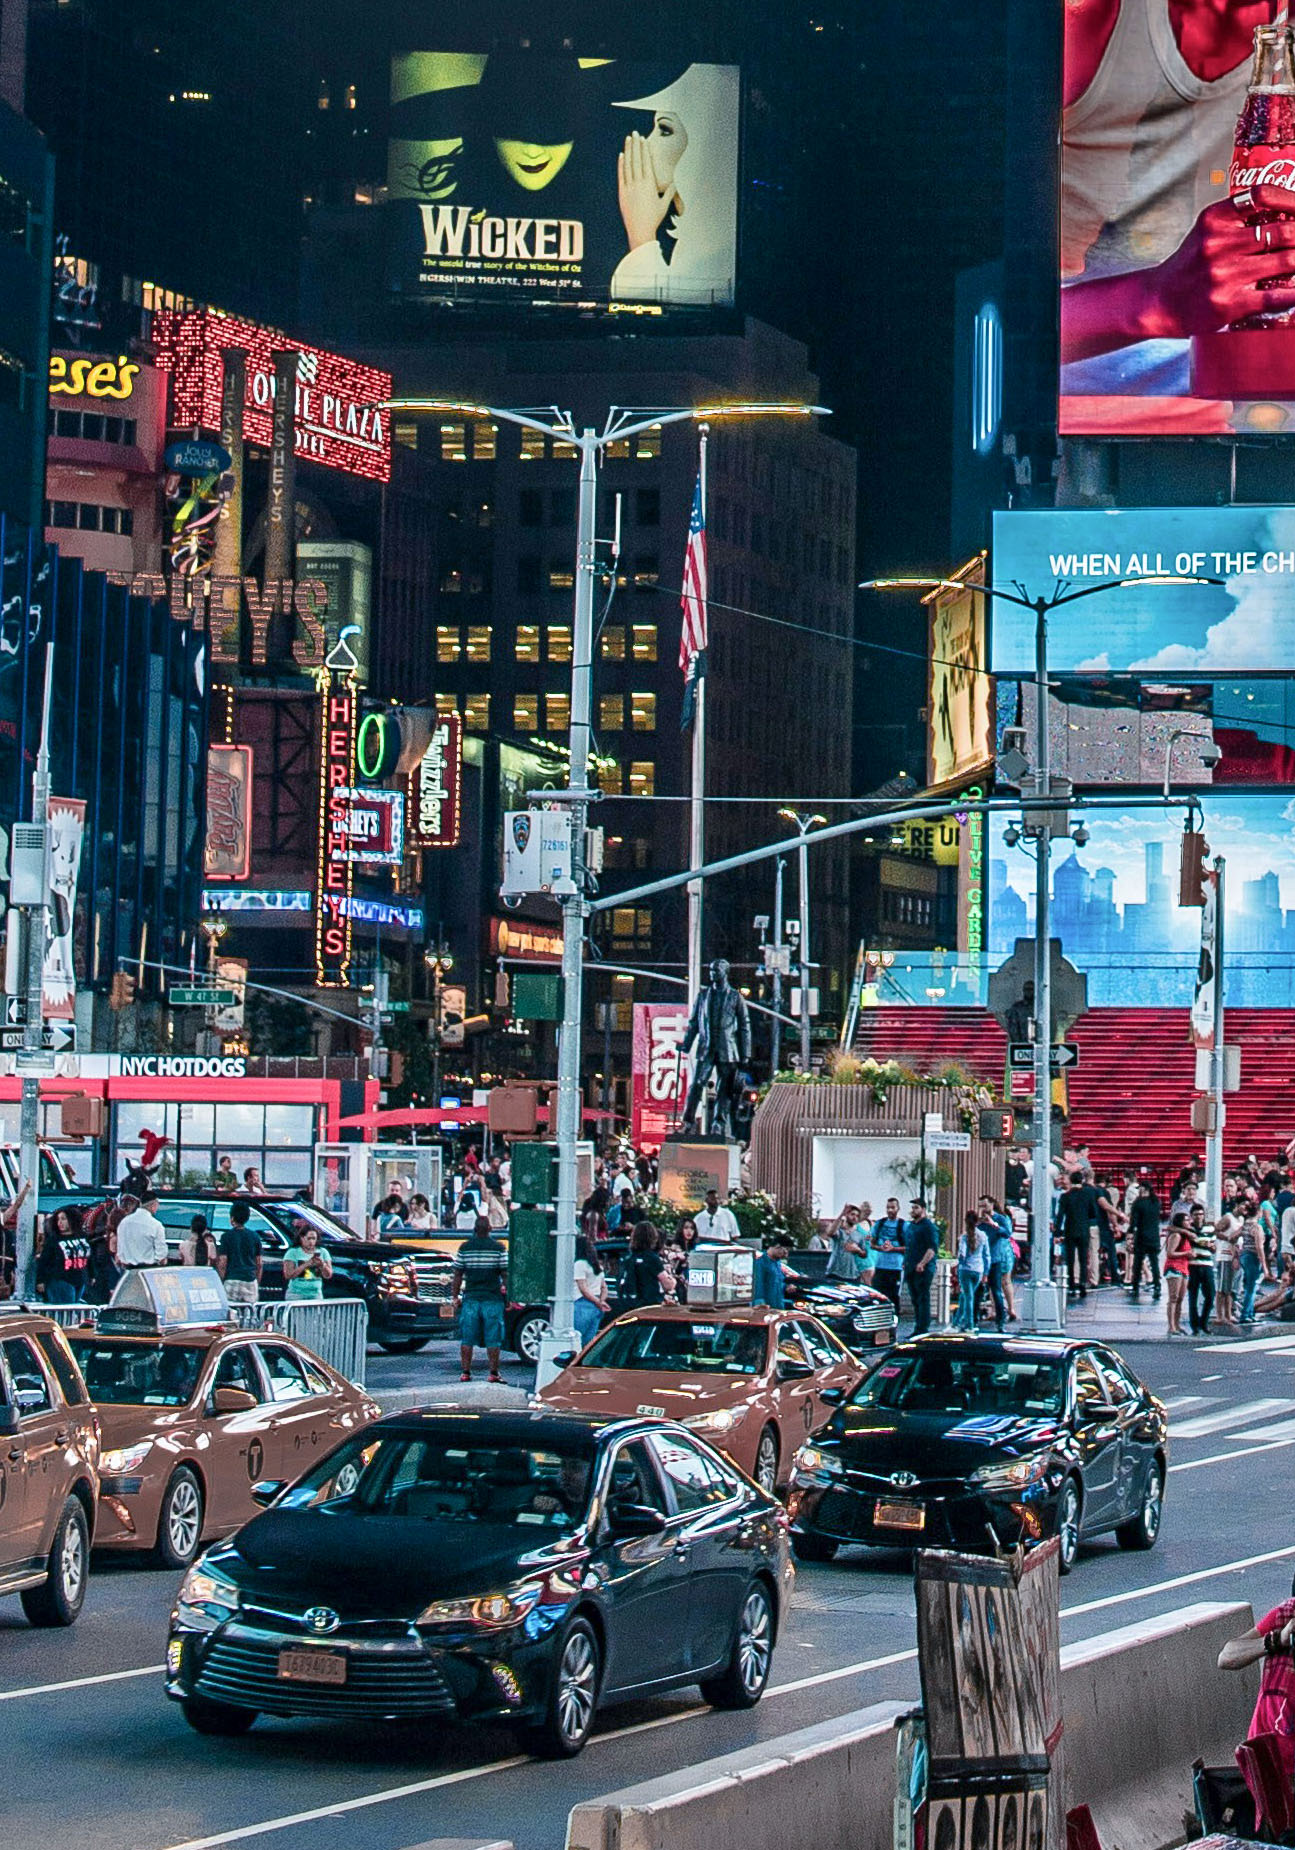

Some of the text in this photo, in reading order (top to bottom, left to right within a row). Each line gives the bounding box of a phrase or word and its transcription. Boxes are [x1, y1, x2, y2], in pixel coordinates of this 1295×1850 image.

[505, 261, 514, 270] of
[529, 263, 559, 272] Witches
[49, 355, 140, 399] ese's
[322, 394, 383, 442] PLAZA
[294, 429, 326, 456] OTEL
[1050, 554, 1121, 576] WHEN
[1126, 553, 1169, 575] ALL
[1175, 553, 1206, 575] OF
[1211, 552, 1257, 574] THE
[325, 697, 351, 955] HERSHEY'S
[967, 889, 983, 977] GARDEN
[184, 991, 194, 1001] W
[1001, 1113, 1014, 1139] 3
